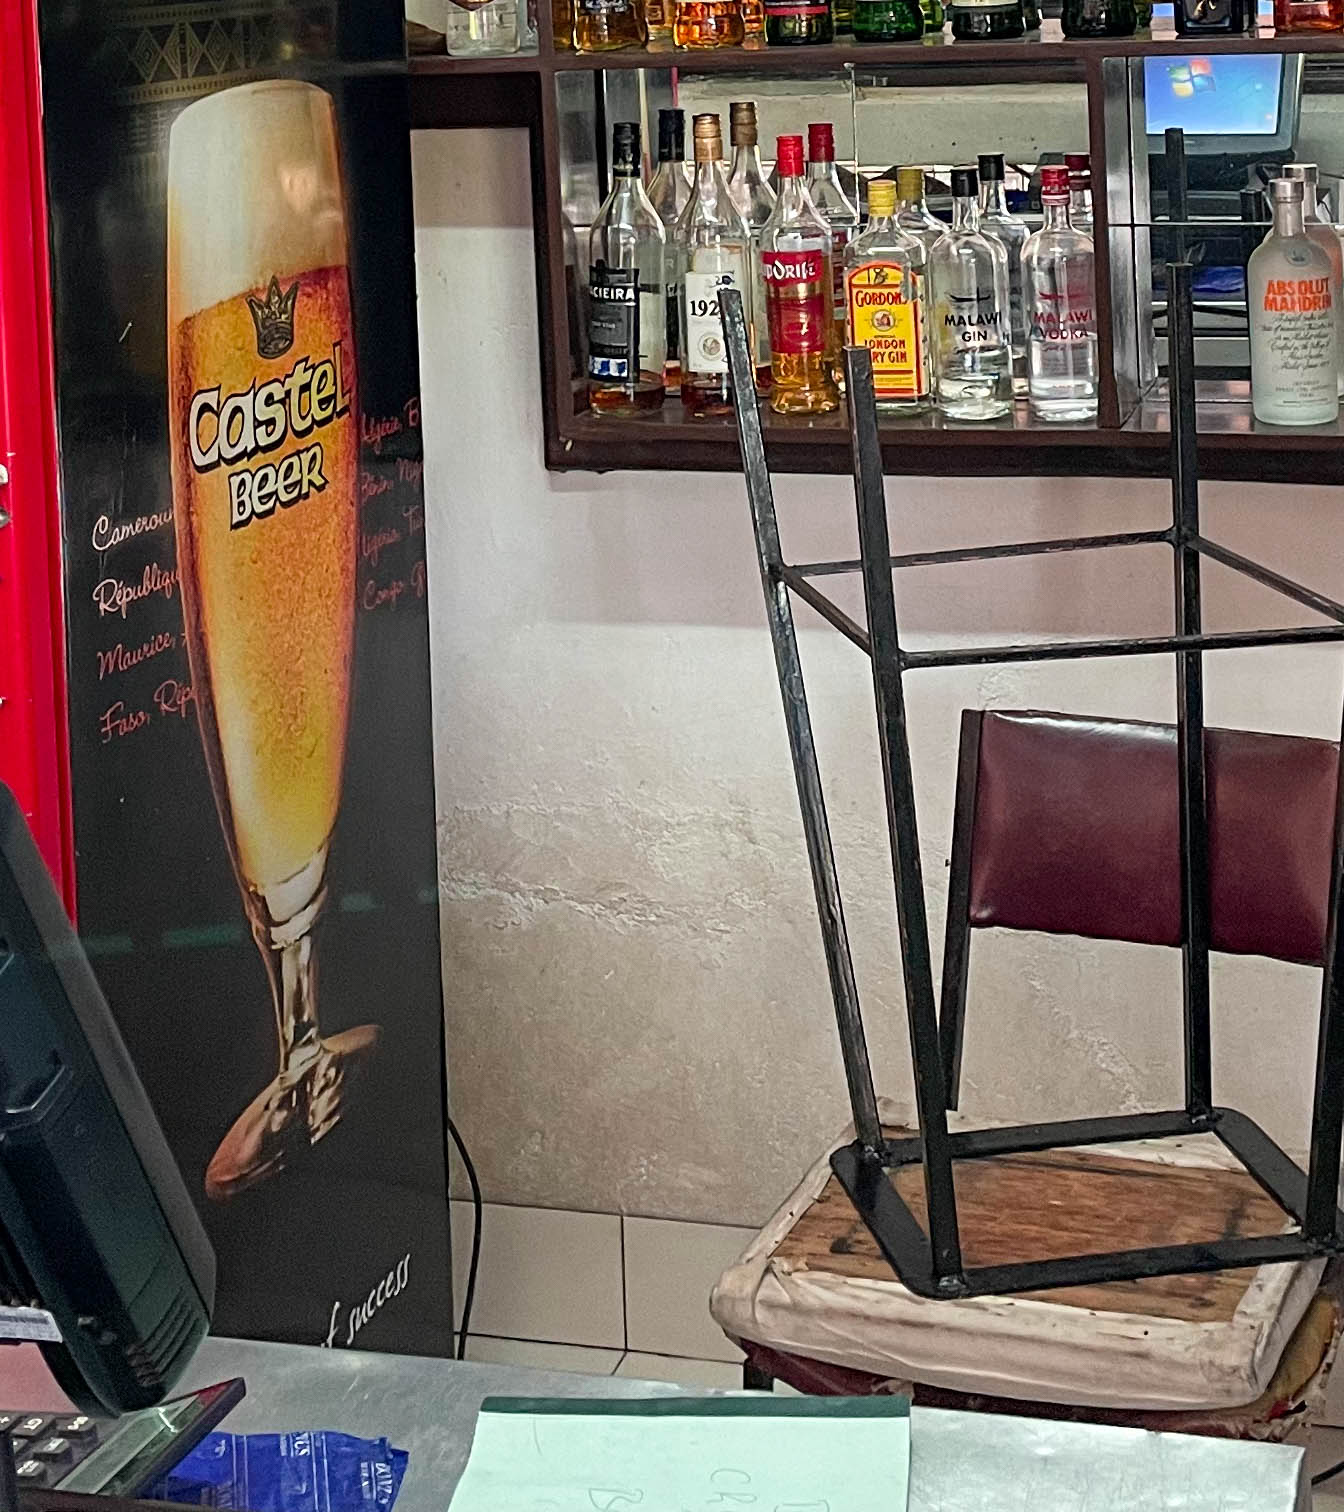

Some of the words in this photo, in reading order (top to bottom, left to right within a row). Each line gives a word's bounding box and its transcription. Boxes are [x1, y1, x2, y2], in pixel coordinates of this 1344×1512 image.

[591, 286, 636, 301] CIEIRA
[1267, 277, 1329, 296] ABSOLUT
[855, 290, 907, 307] GORDON
[690, 299, 721, 317] 192
[944, 311, 1003, 328] MALAWI
[1033, 309, 1093, 325] MALAWI
[962, 330, 988, 343] GIN
[1040, 327, 1090, 340] VODKA
[864, 339, 906, 350] LONDON
[872, 351, 886, 364] RY
[887, 350, 907, 363] GIN
[189, 341, 350, 472] Castel
[229, 443, 327, 530] BEER
[92, 562, 181, 620] Républiqu
[347, 1253, 411, 1346] success
